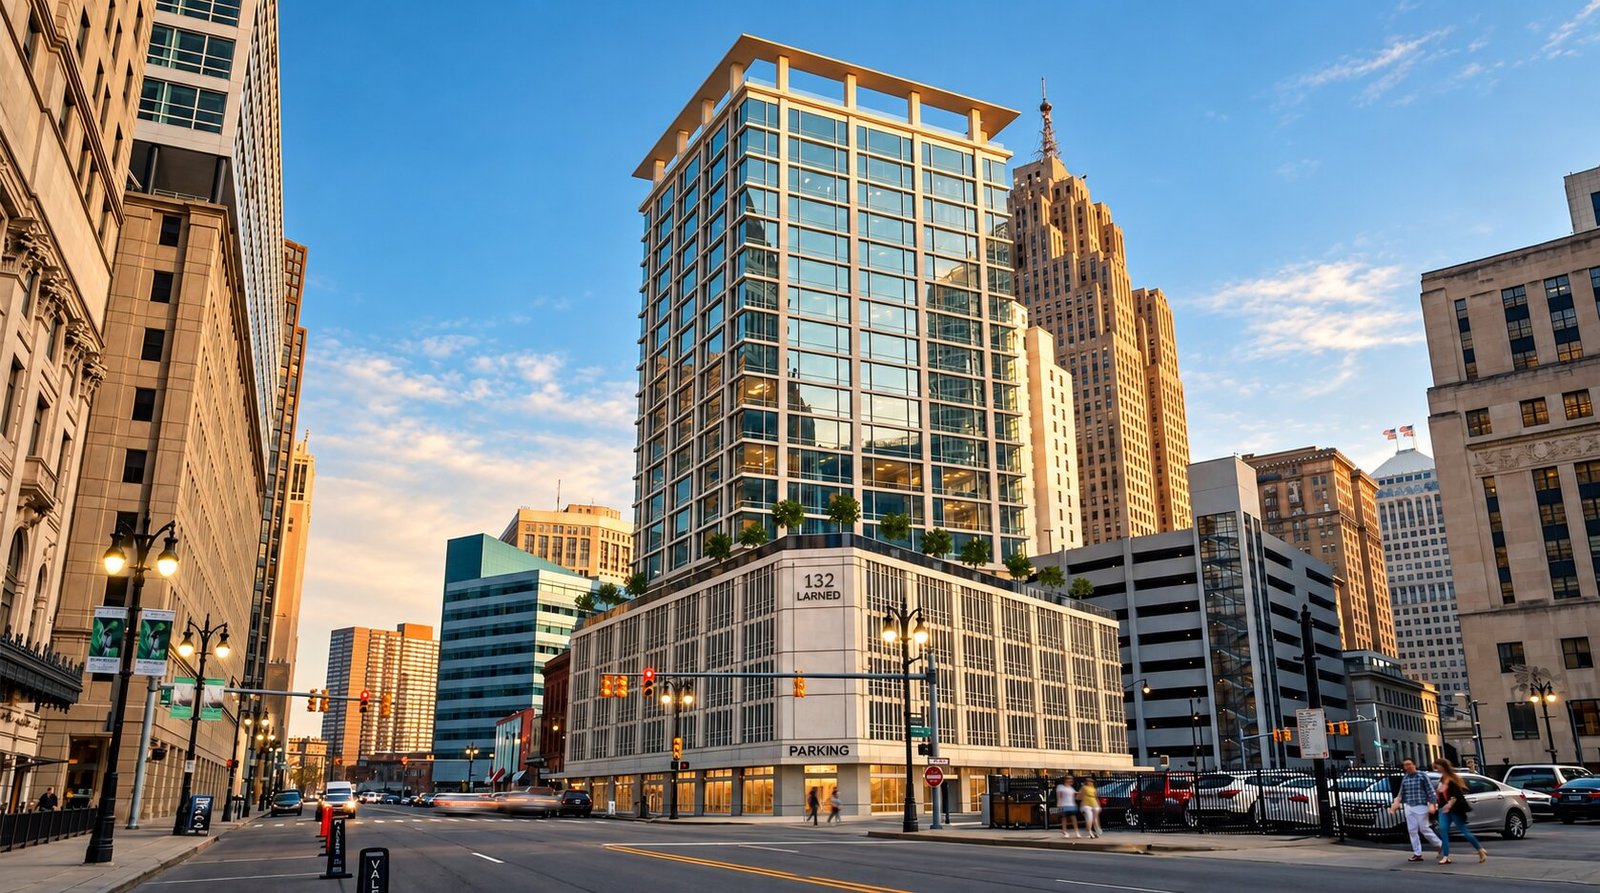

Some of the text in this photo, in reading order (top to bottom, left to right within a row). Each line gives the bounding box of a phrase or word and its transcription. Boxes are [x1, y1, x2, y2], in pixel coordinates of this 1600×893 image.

[804, 573, 834, 588] 132
[797, 591, 841, 601] LARNED
[789, 745, 849, 756] PARKING
